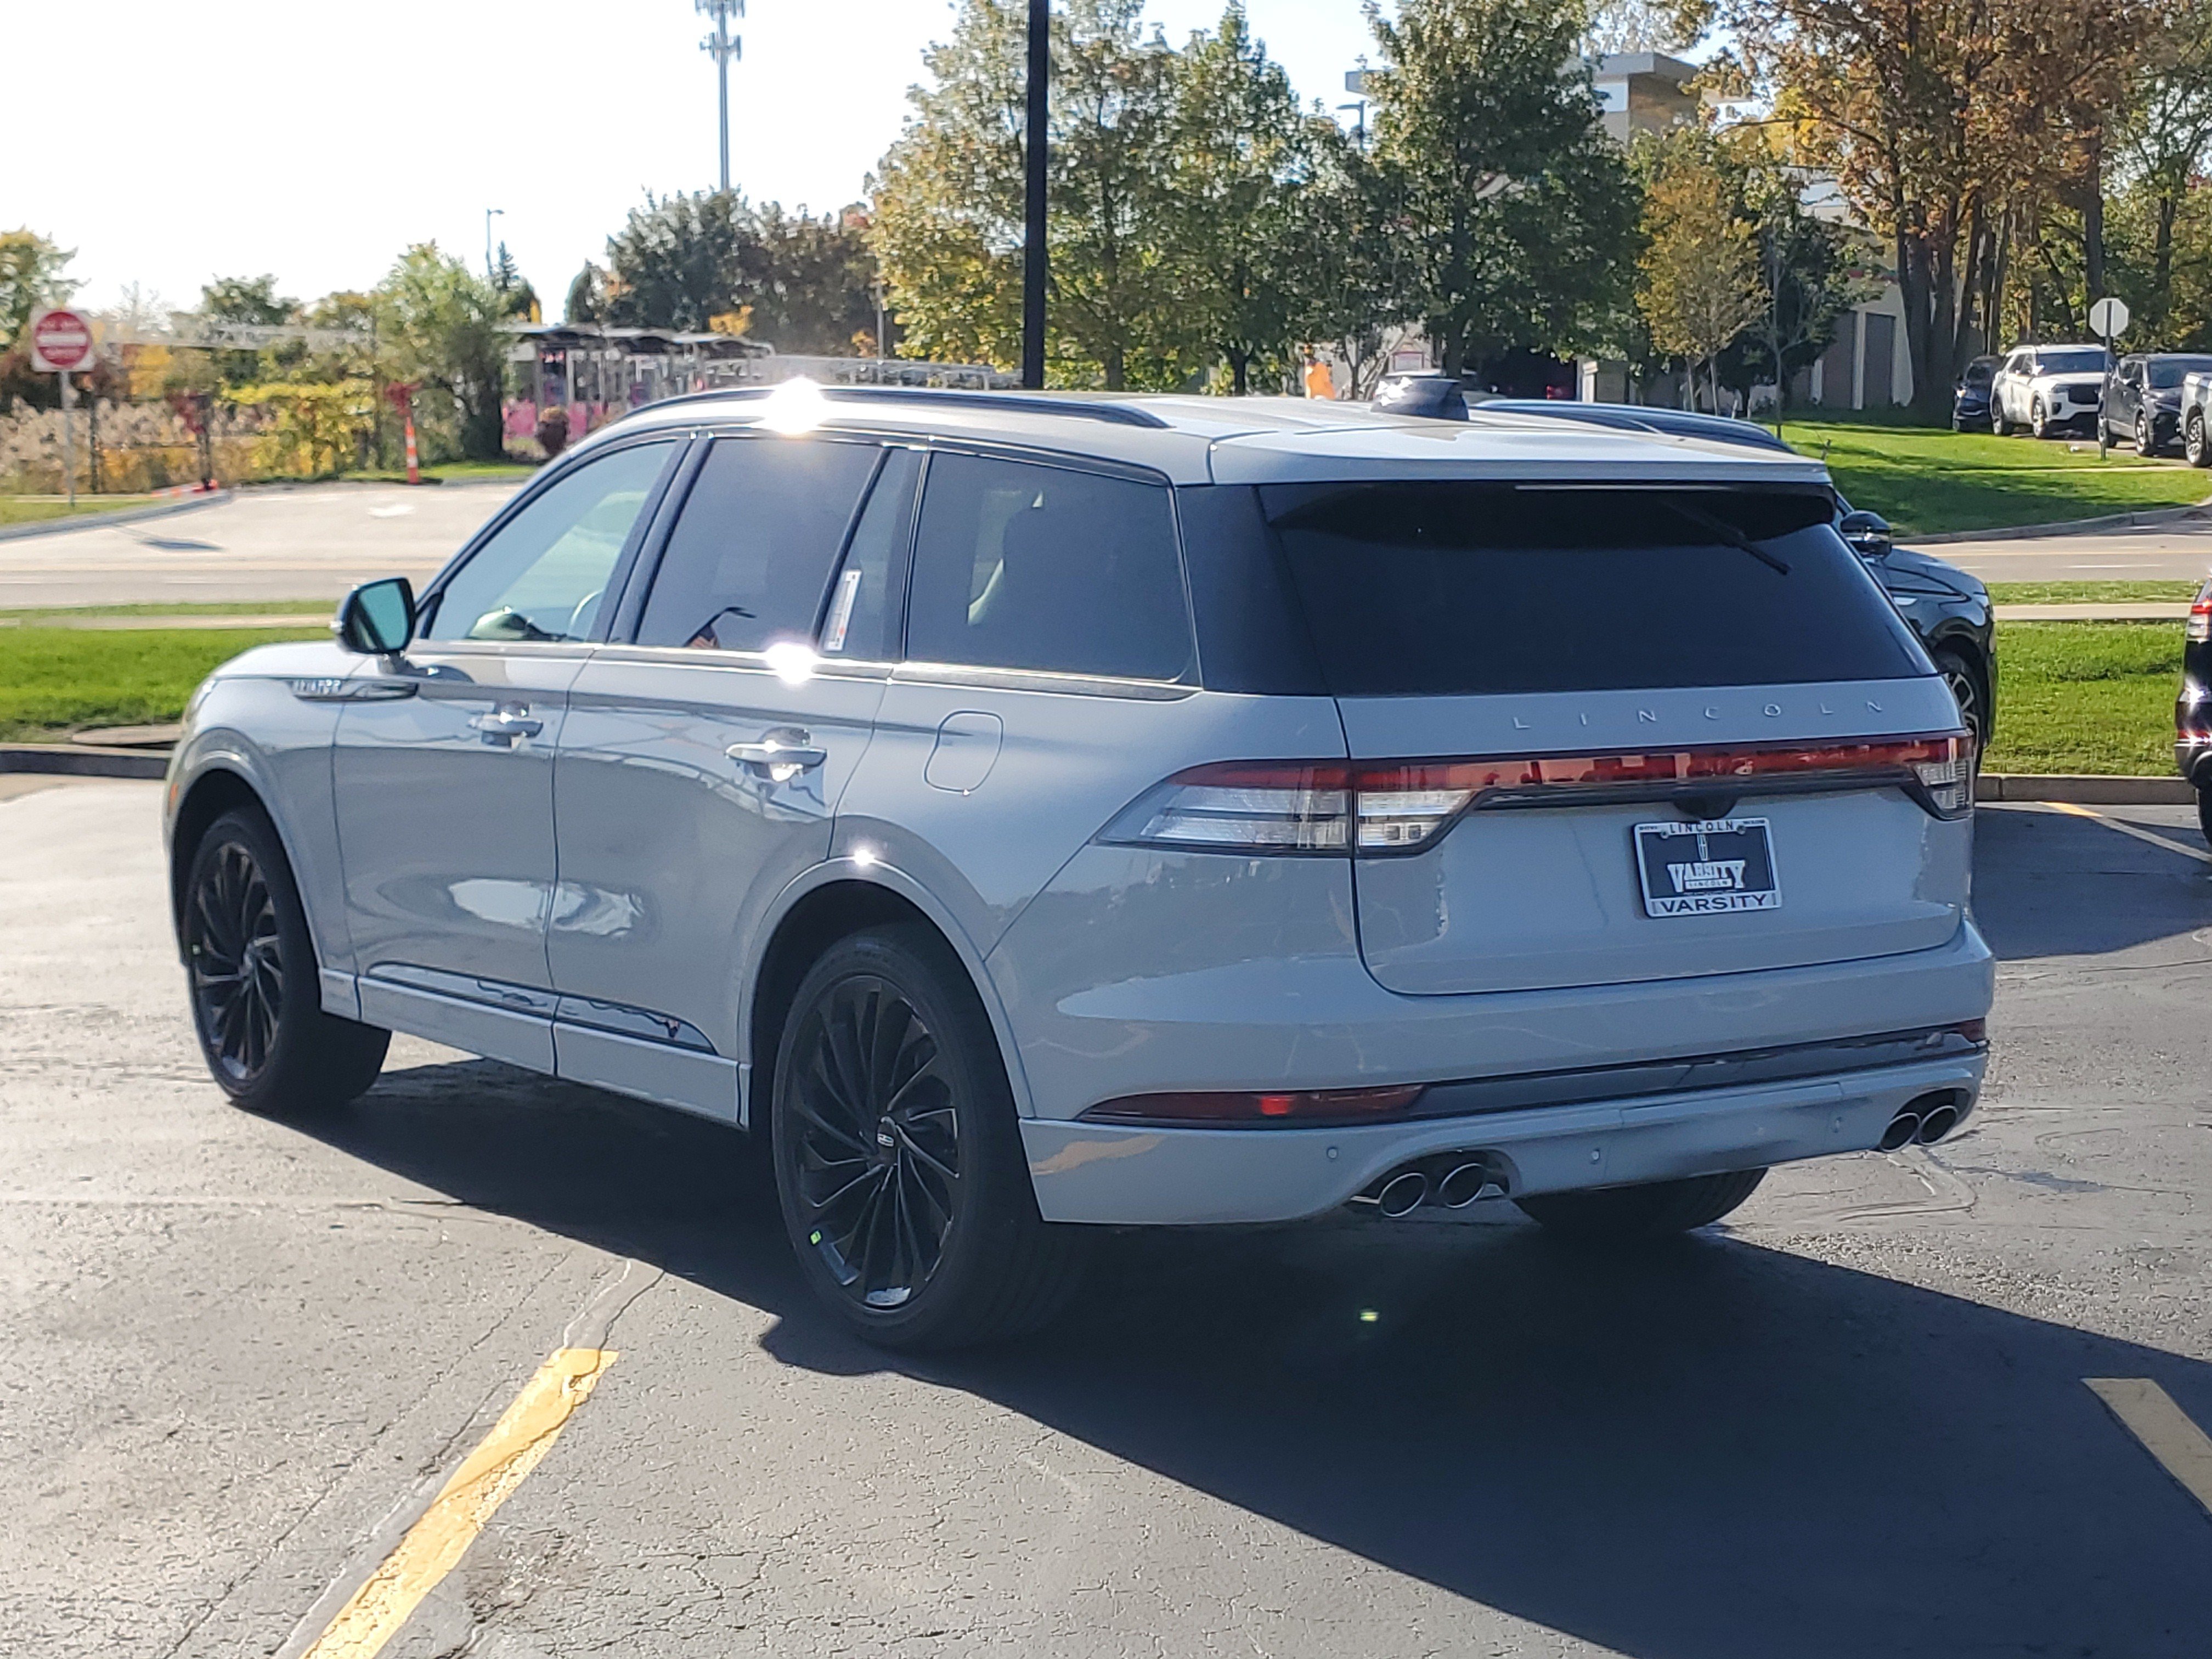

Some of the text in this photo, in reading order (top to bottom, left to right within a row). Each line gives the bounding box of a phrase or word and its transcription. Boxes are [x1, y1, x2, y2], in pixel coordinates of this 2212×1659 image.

[1514, 701, 1883, 729] LINCOLN
[1669, 821, 1734, 834] LINCOLN
[1667, 860, 1745, 893] VARSITY
[1660, 894, 1767, 912] VARSITY
